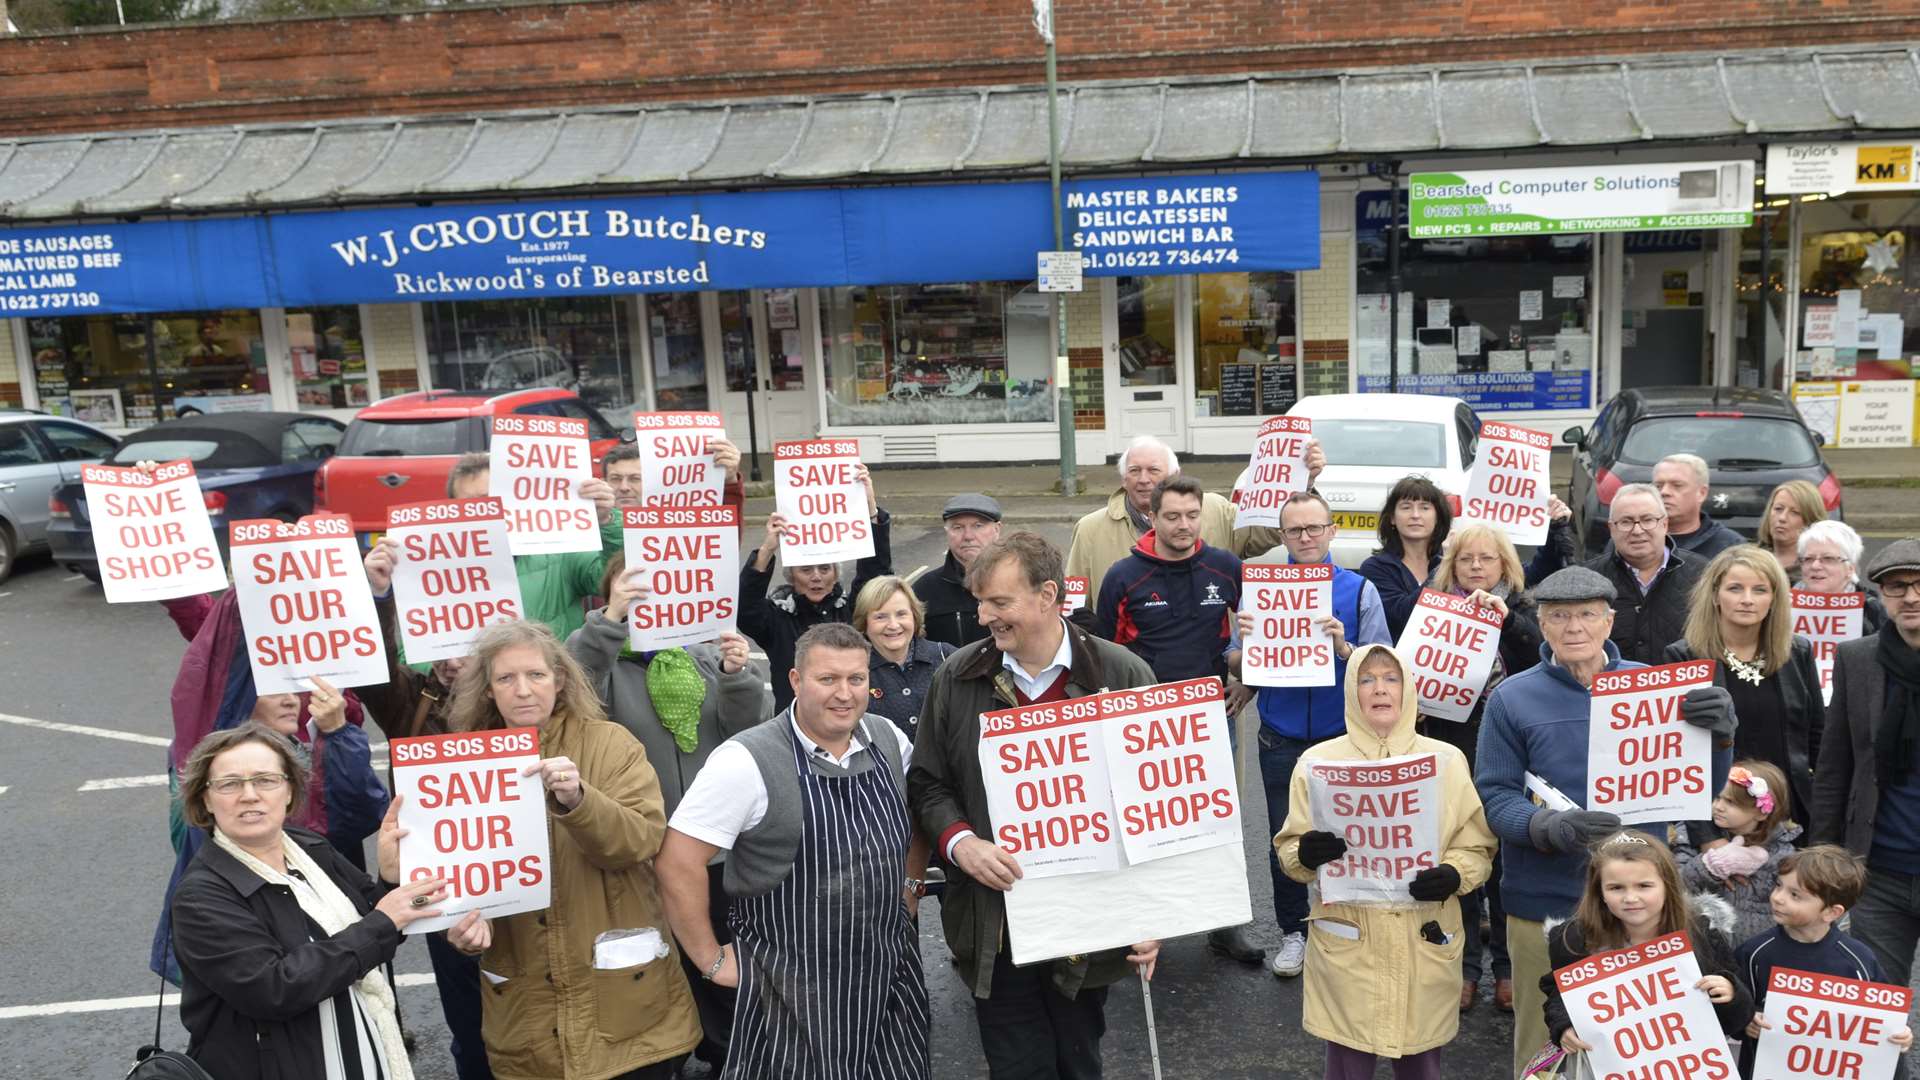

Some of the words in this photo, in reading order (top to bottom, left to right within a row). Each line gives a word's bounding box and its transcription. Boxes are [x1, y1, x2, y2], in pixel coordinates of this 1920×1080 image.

[1785, 144, 1839, 159] Taylor's
[1858, 162, 1895, 179] KM
[1067, 190, 1149, 208] MASTER
[1156, 186, 1238, 205] BAKERS
[1412, 182, 1493, 199] Bearsted
[1499, 179, 1588, 196] Computer
[1594, 175, 1681, 192] Solutions
[606, 210, 766, 249] Butchers
[1078, 207, 1227, 228] DELICATESSEN
[1415, 225, 1442, 236] NEW
[1445, 224, 1472, 234] PC'S
[1490, 221, 1541, 232] REPAIRS
[1560, 217, 1641, 230] NETWORKING
[1660, 214, 1746, 226] ACCESSORIES
[24, 235, 113, 252] SAUSAGES
[543, 241, 569, 250] 1977
[1073, 228, 1184, 248] SANDWICH
[1191, 227, 1234, 243] BAR
[0, 255, 79, 272] MATURED
[82, 253, 122, 268] BEEF
[506, 252, 587, 266] incorporating
[1082, 253, 1103, 268] el.
[1105, 252, 1160, 268] 01622
[1166, 248, 1239, 265] 736474
[30, 273, 76, 288] LAMB
[394, 267, 545, 294] Rickwood's
[556, 266, 582, 288] of
[591, 261, 709, 288] Bearsted
[41, 292, 100, 308] 737130
[1421, 374, 1477, 385] COMPUTER
[1479, 373, 1535, 384] SOLUTIONS
[495, 418, 524, 432] SOS
[528, 419, 556, 432] SOS
[559, 421, 585, 435] SOS
[637, 415, 664, 427] SOS
[667, 415, 693, 426] SOS
[696, 415, 721, 426] SOS
[1291, 420, 1310, 430] SOS
[1848, 425, 1902, 433] NEWSPAPER
[653, 435, 715, 458] SAVE
[1484, 425, 1507, 437] SOS
[1509, 428, 1528, 440] SOS
[1530, 434, 1549, 446] SOS
[506, 443, 578, 469] SAVE
[778, 445, 802, 456] SOS
[806, 444, 831, 455] SOS
[835, 443, 856, 453] SOS
[1257, 438, 1302, 460] SAVE
[1488, 446, 1541, 472] SAVE
[85, 468, 117, 482] SOS
[121, 471, 154, 485] SOS
[156, 463, 189, 480] SOS
[662, 463, 705, 487] OUR
[789, 464, 852, 487] SAVE
[1254, 464, 1291, 484] OUR
[1488, 474, 1536, 499] OUR
[513, 477, 570, 501] OUR
[104, 488, 186, 517] SAVE
[391, 507, 421, 524] SOS
[426, 504, 459, 519] SOS
[463, 501, 500, 516] SOS
[799, 493, 847, 516] OUR
[1467, 498, 1545, 527] SHOPS
[627, 511, 658, 524] SOS
[664, 510, 696, 524] SOS
[701, 509, 733, 522] SOS
[1349, 515, 1376, 528] VDG
[119, 522, 186, 549] OUR
[234, 523, 271, 541] SOS
[314, 518, 349, 535] SOS
[785, 520, 867, 546] SHOPS
[404, 529, 492, 562] SAVE
[642, 535, 721, 562] SAVE
[106, 547, 214, 580] SHOPS
[253, 548, 347, 585] SAVE
[1245, 568, 1270, 578] SOS
[1274, 568, 1299, 579] SOS
[1304, 567, 1329, 578] SOS
[421, 566, 490, 597] OUR
[653, 569, 714, 595] OUR
[270, 589, 346, 625] OUR
[1257, 589, 1318, 610] SAVE
[1422, 593, 1447, 607] SOS
[1449, 600, 1475, 614] SOS
[1478, 608, 1502, 624] SOS
[1797, 594, 1826, 607] SOS
[1830, 596, 1860, 607] SOS
[634, 597, 733, 630] SHOPS
[1264, 618, 1311, 639] OUR
[1420, 615, 1487, 653] SAVE
[255, 626, 377, 667] SHOPS
[1247, 645, 1329, 668] SHOPS
[1415, 645, 1468, 679] OUR
[1596, 675, 1631, 692] SOS
[1637, 670, 1671, 687] SOS
[1676, 664, 1709, 681] SOS
[1102, 695, 1138, 714] SOS
[1144, 688, 1177, 707] SOS
[1183, 682, 1219, 701] SOS
[1020, 708, 1056, 727] SOS
[1062, 702, 1097, 720] SOS
[1122, 712, 1210, 754] SAVE
[396, 742, 437, 760] SOS
[442, 738, 485, 757] SOS
[491, 734, 533, 753] SOS
[999, 731, 1090, 774] SAVE
[1618, 732, 1682, 766] OUR
[1138, 754, 1206, 792] OUR
[1356, 770, 1392, 782] SOS
[1398, 762, 1431, 779] SOS
[1595, 765, 1704, 804] SHOPS
[417, 768, 520, 809] SAVE
[1015, 774, 1086, 812] OUR
[1123, 788, 1233, 836] SHOPS
[1333, 789, 1420, 817] SAVE
[433, 815, 513, 853] OUR
[999, 812, 1110, 854] SHOPS
[1345, 824, 1412, 849] OUR
[1560, 962, 1598, 986] SOS
[1601, 951, 1640, 971] SOS
[1645, 937, 1684, 957] SOS
[1588, 967, 1685, 1023] SAVE
[1774, 973, 1814, 993] SOS
[1819, 980, 1860, 1000] SOS
[1865, 987, 1905, 1007] SOS
[1614, 1012, 1690, 1059] OUR
[1784, 1005, 1883, 1046] SAVE
[1787, 1045, 1863, 1080] OUR
